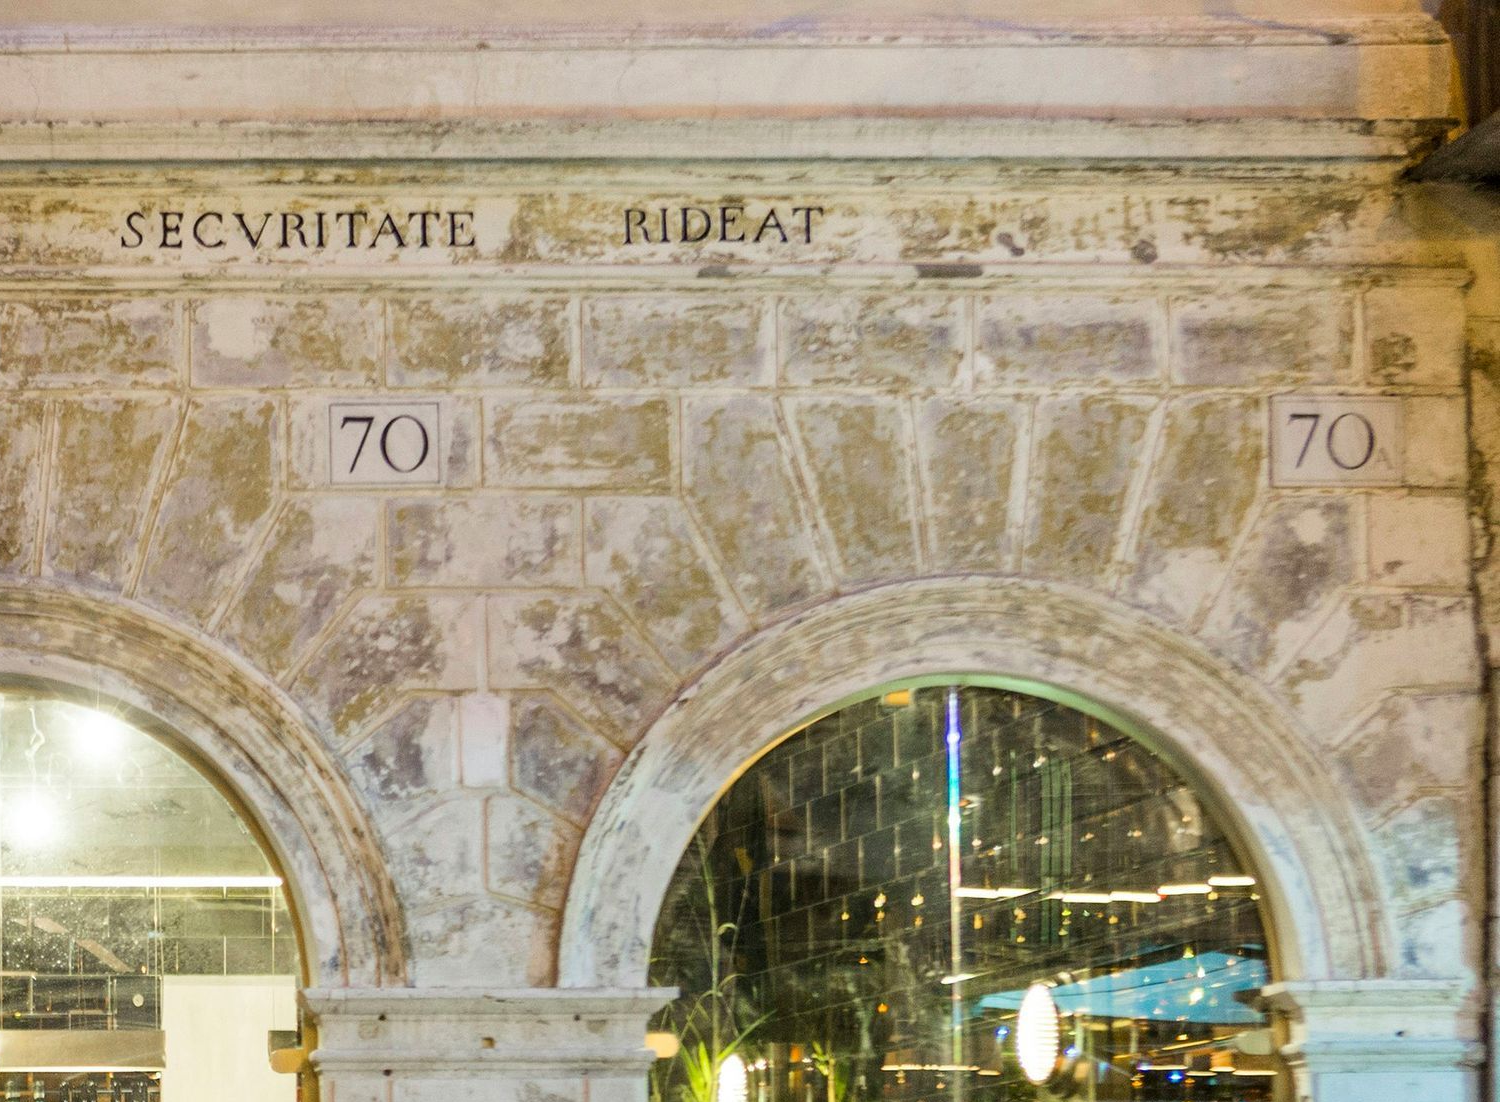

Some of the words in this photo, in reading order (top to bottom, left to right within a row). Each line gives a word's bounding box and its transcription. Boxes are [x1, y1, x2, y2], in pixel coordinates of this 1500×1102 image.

[120, 209, 478, 250] SECVRITATE
[622, 205, 825, 246] RIDEAT
[339, 413, 431, 474] 70
